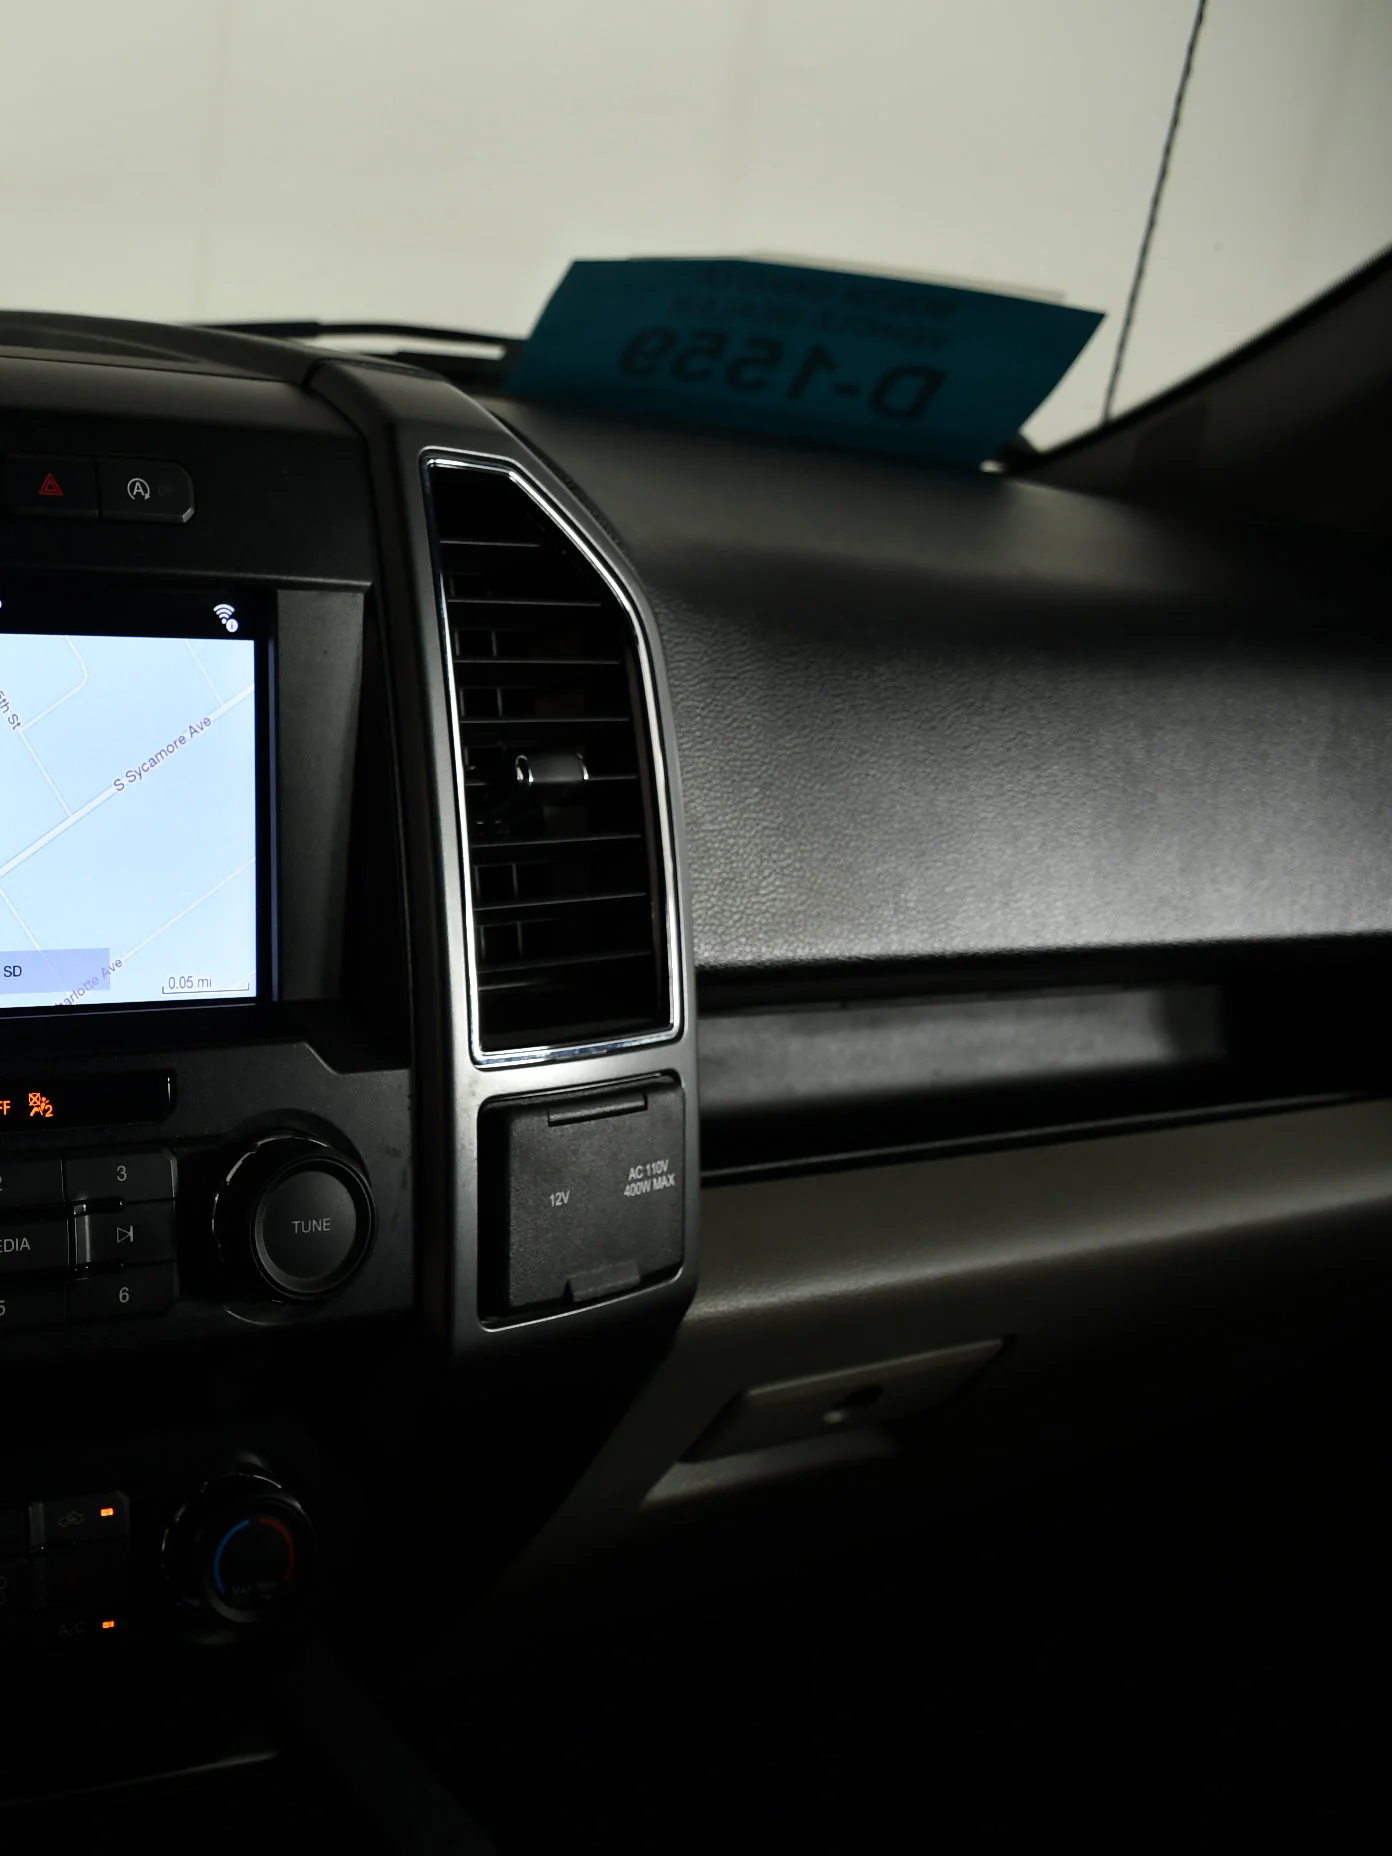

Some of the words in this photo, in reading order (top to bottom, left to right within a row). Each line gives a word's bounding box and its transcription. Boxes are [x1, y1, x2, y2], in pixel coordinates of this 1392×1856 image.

[7, 713, 22, 731] St
[113, 778, 126, 792] S
[124, 734, 187, 784] Sycamore
[188, 715, 212, 738] Ave
[3, 965, 23, 978] SD
[101, 959, 123, 979] Ave
[168, 976, 194, 990] 0.05
[197, 975, 212, 989] mi
[116, 1165, 129, 1182] 3
[628, 1165, 644, 1181] AC
[645, 1159, 670, 1176] 110V
[623, 1178, 652, 1198] 400W
[652, 1173, 676, 1192] MAX
[548, 1190, 571, 1207] 12V
[291, 1217, 332, 1234] TUNE
[118, 1286, 131, 1303] 6
[58, 1619, 86, 1637] A/C
